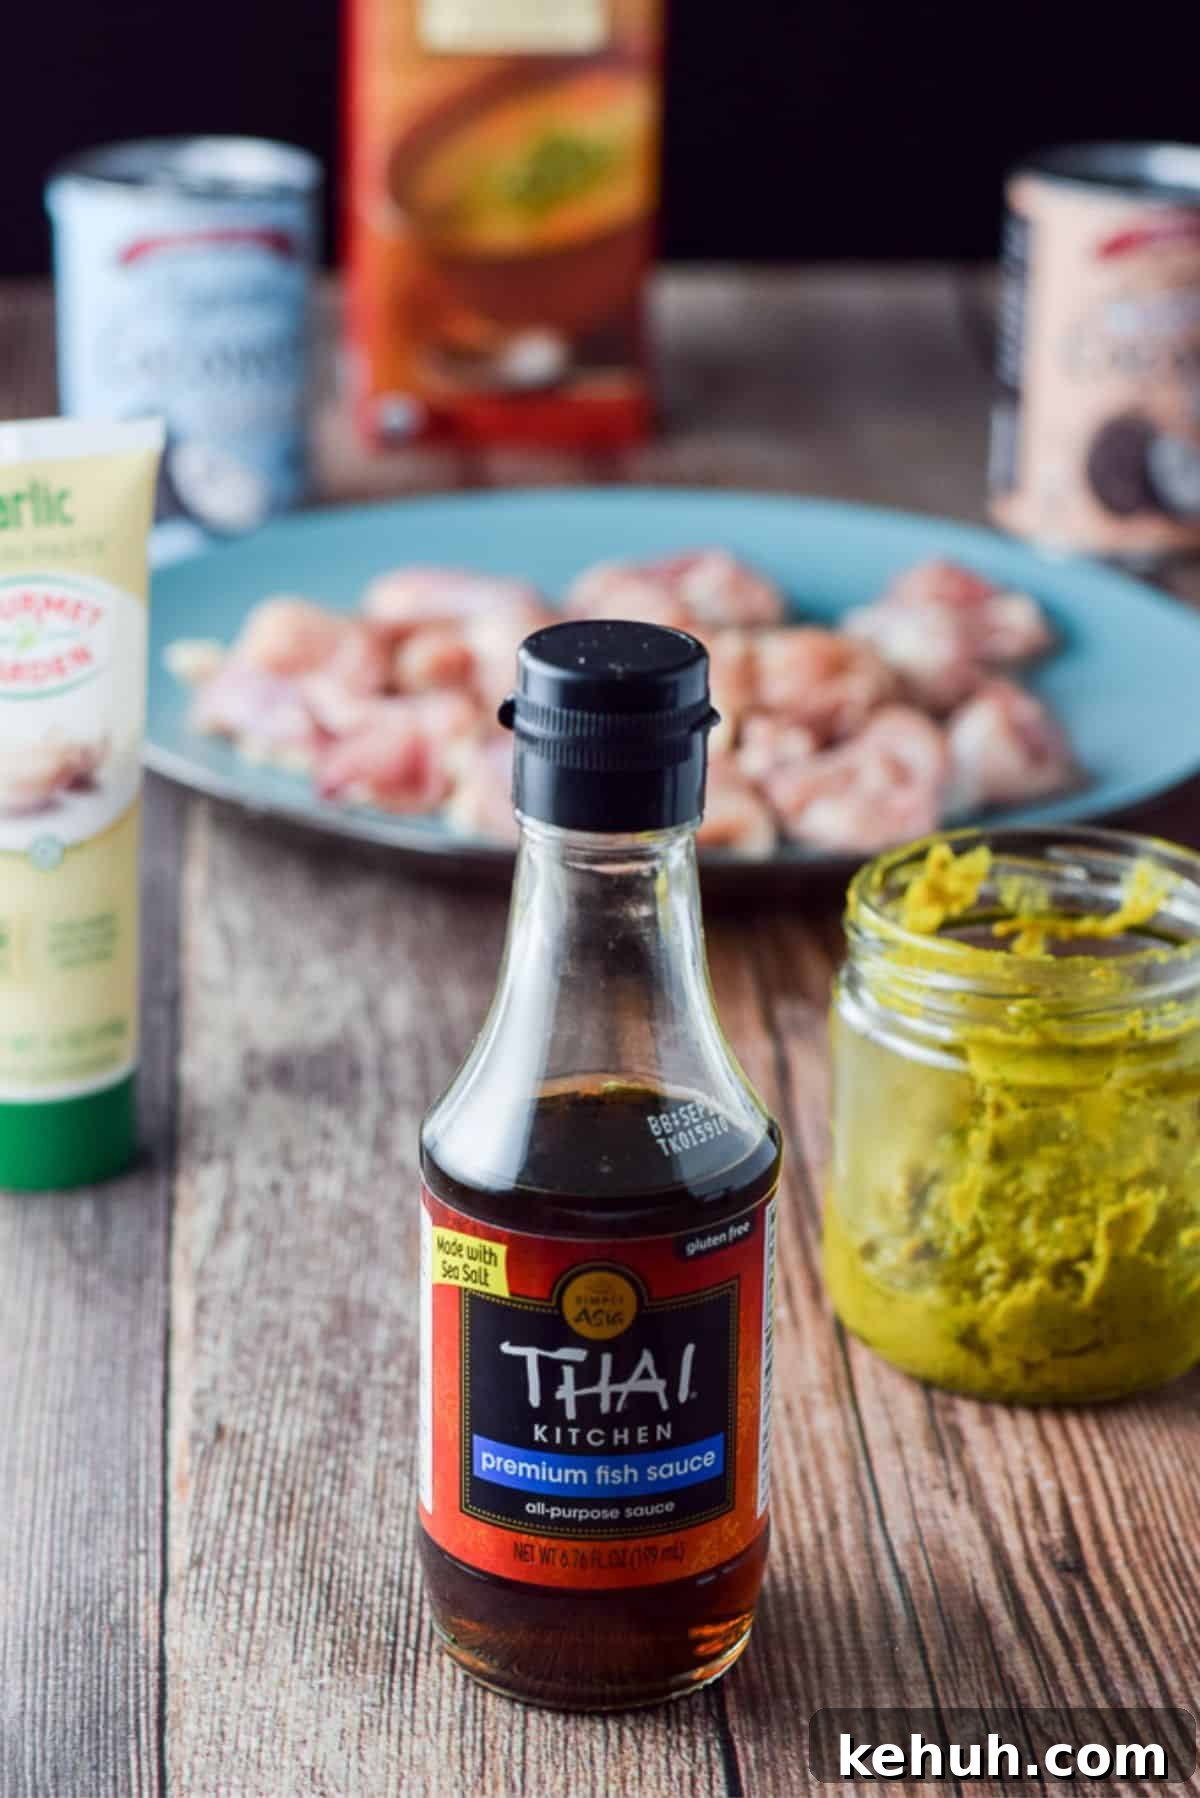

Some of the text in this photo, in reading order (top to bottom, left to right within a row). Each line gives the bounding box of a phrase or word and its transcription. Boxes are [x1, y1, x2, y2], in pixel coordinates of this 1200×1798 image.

[436, 1235, 498, 1267] Made with
[685, 1221, 751, 1256] gluten free
[441, 1259, 489, 1287] Sea Salt
[500, 1341, 696, 1420] THAI
[533, 1423, 672, 1447] KITCHEN
[480, 1450, 716, 1485] premium fish sauce
[525, 1501, 675, 1521] all-purpose sauce
[513, 1542, 536, 1563] NET
[538, 1544, 558, 1565] WT
